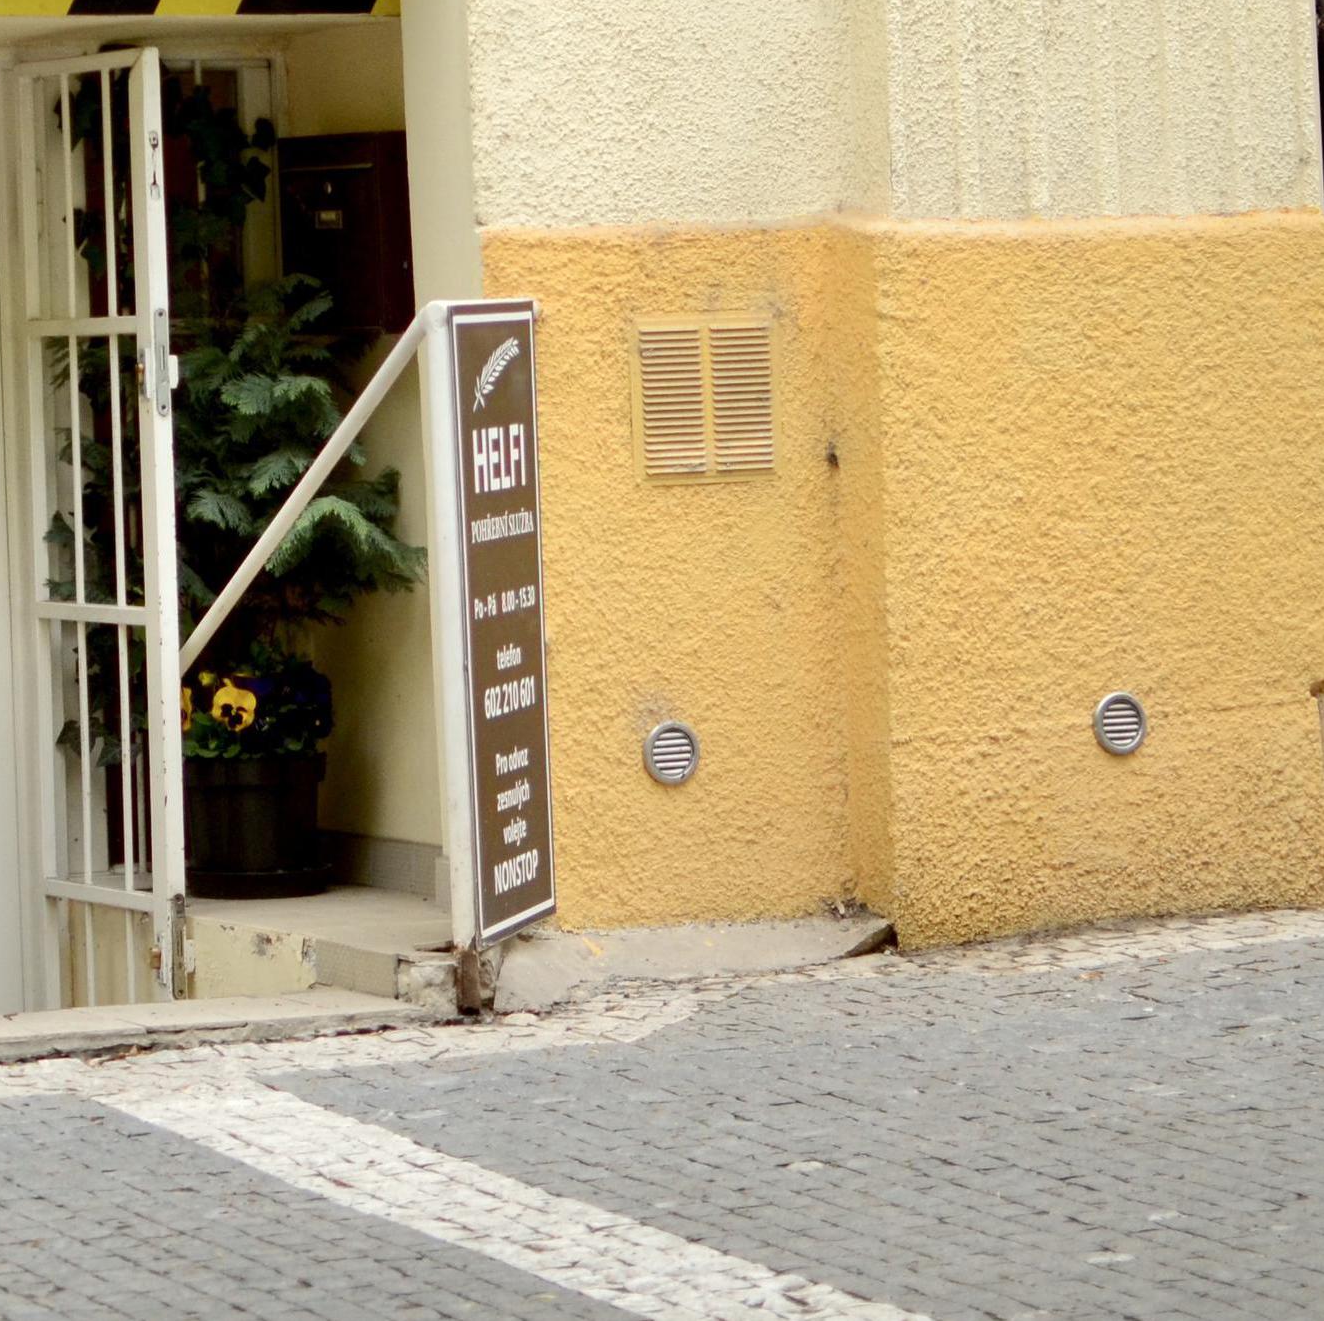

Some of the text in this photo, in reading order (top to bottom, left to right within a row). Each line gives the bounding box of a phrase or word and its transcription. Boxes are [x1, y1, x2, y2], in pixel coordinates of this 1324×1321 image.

[472, 424, 526, 494] HELFI
[471, 508, 534, 544] POHŘEBNÍ SLUŽBA
[474, 598, 483, 620] Po
[488, 594, 496, 616] Pá
[502, 591, 514, 613] 8.00
[520, 586, 535, 608] 15.30
[496, 643, 521, 671] telefon
[485, 675, 535, 720] 602 210 601
[495, 747, 528, 776] Pro odvoz
[497, 778, 530, 812] zesnulých
[503, 818, 527, 846] volejte
[494, 849, 539, 896] NONSTOP
